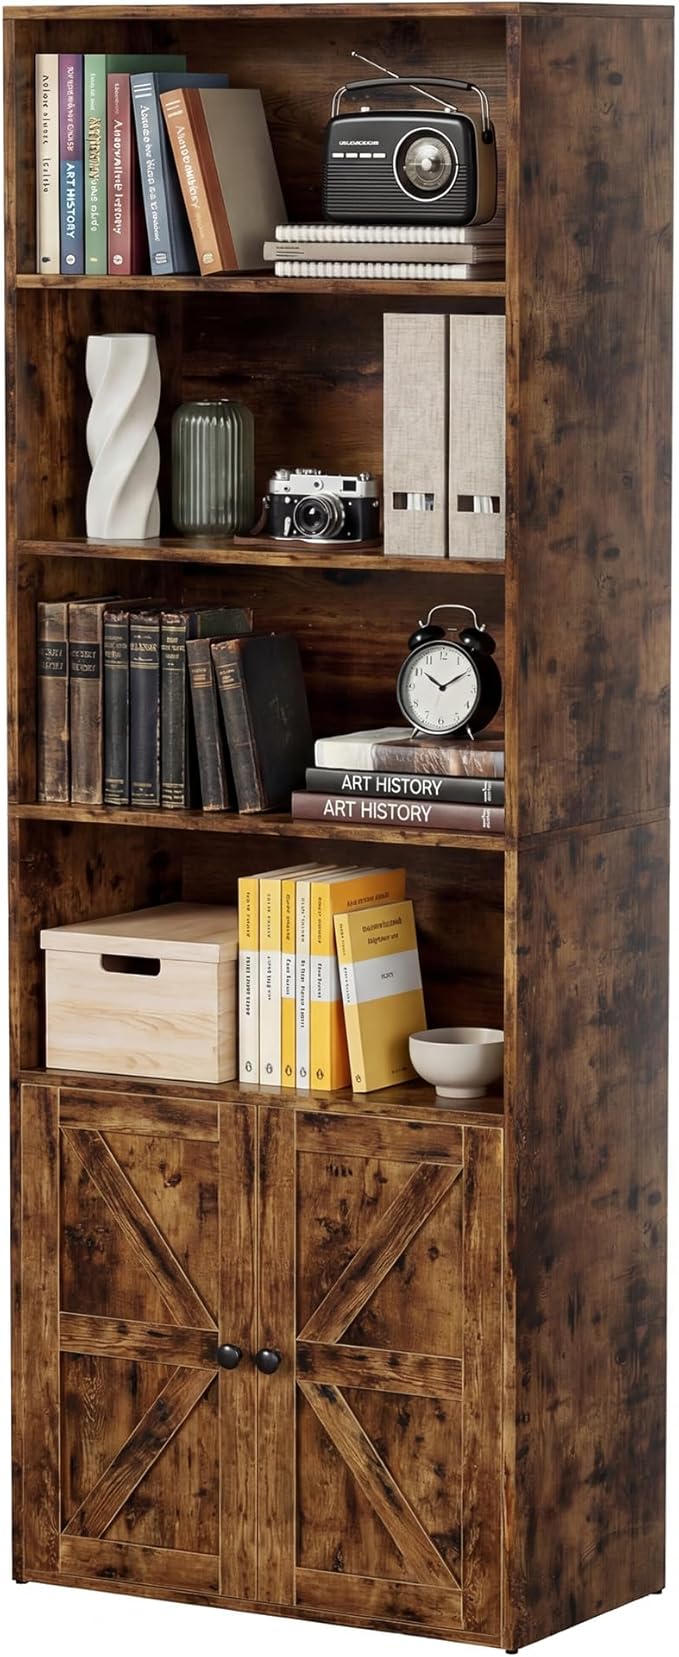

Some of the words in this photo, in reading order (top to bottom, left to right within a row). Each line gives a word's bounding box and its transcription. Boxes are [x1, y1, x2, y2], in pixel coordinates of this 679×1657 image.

[66, 162, 76, 187] ART
[66, 188, 76, 239] HISTORY
[425, 655, 433, 665] 11
[440, 650, 448, 661] 12
[341, 774, 372, 791] ART
[375, 777, 443, 796] HISTORY
[323, 799, 356, 817] ART
[360, 801, 433, 823] HISTORY
